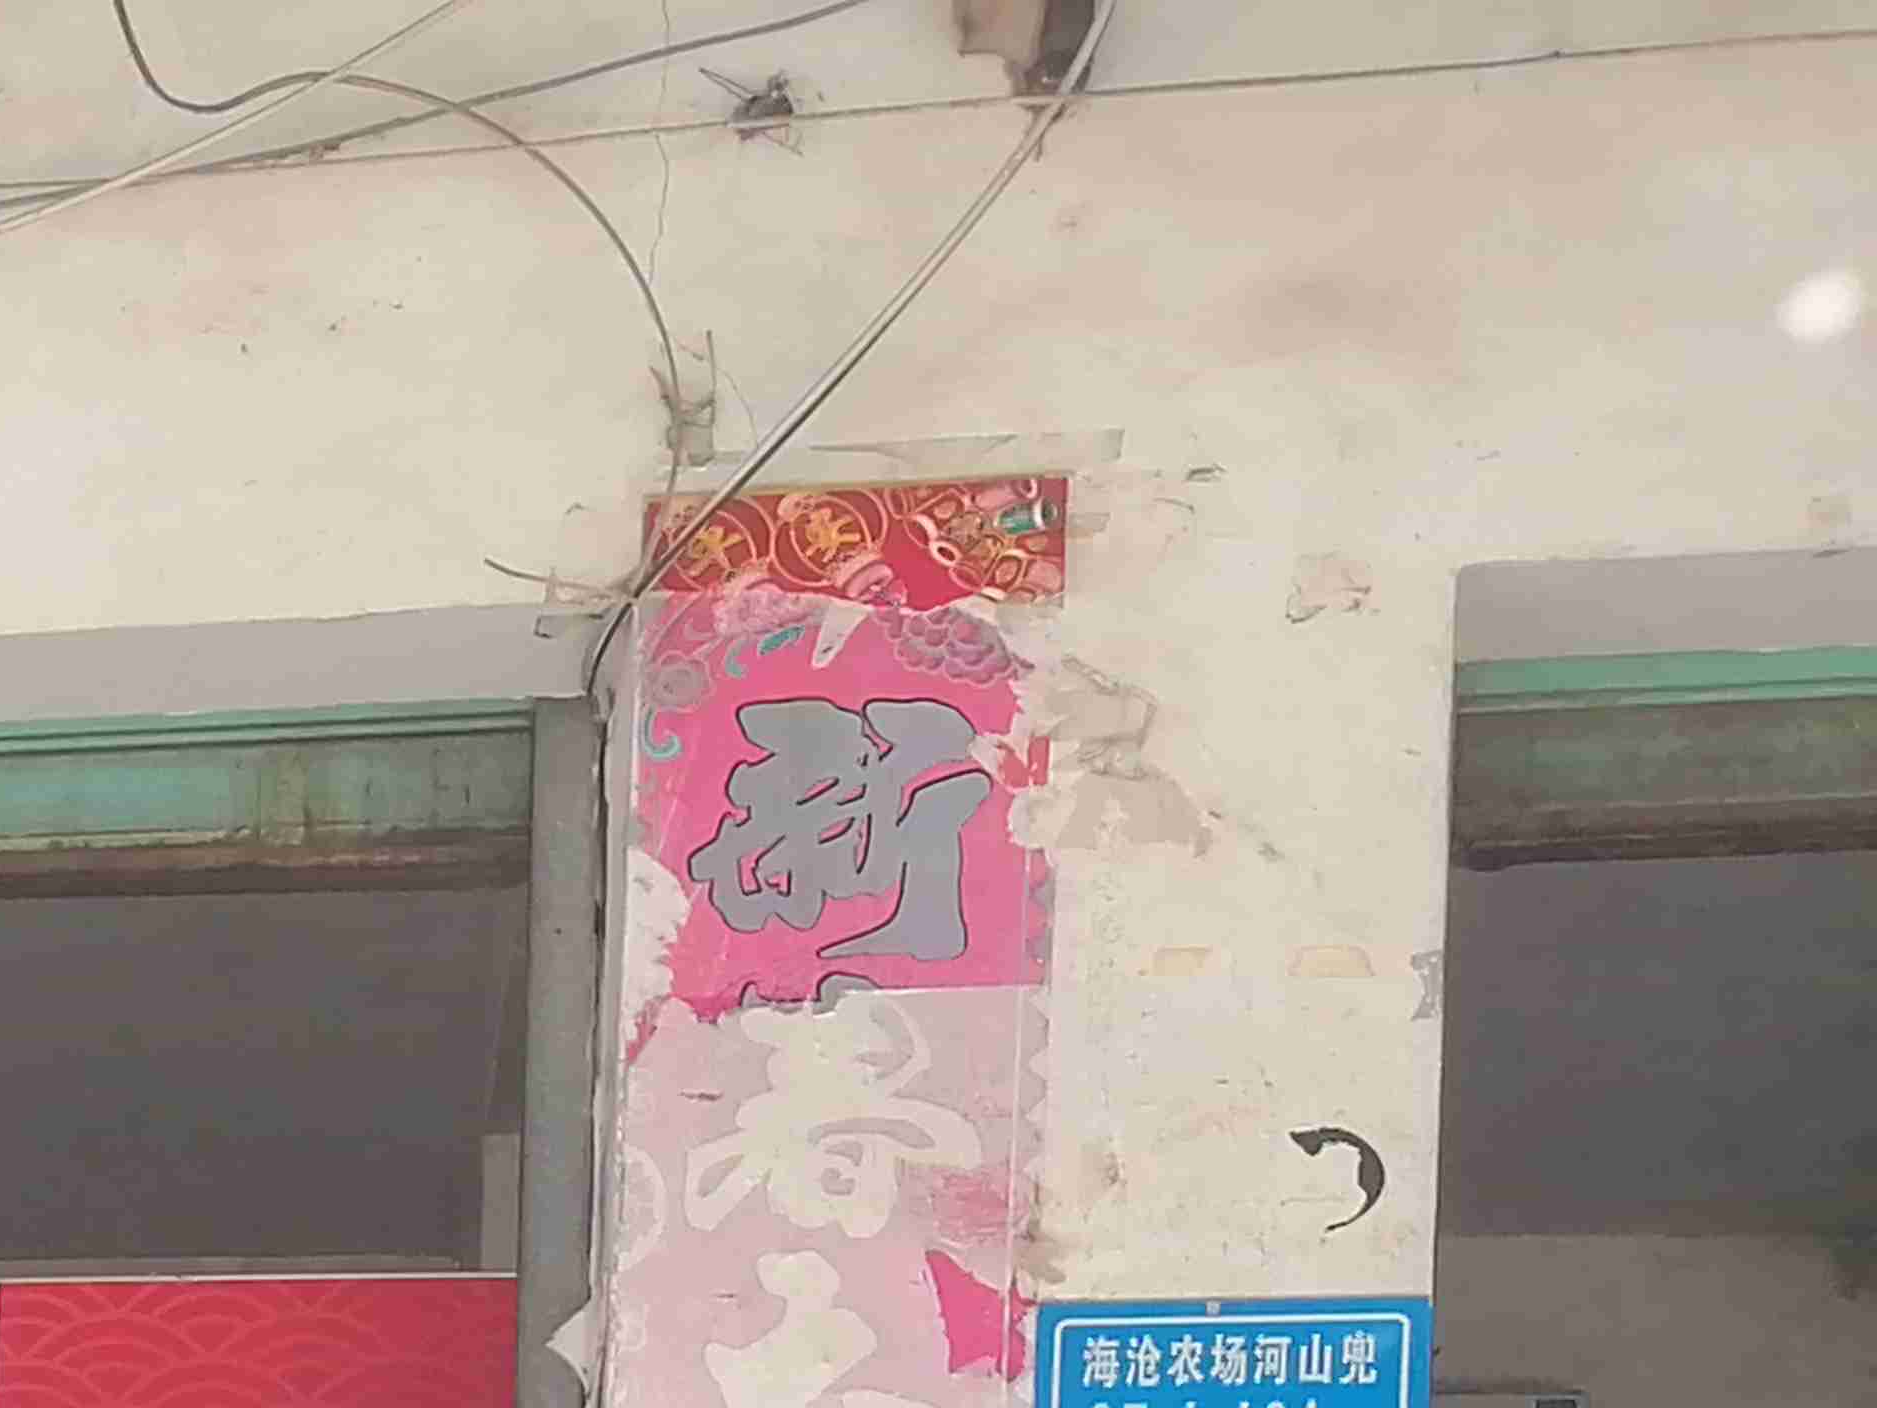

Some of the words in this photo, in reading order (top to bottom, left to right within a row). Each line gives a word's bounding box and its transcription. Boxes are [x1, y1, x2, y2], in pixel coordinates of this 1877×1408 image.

[1081, 1330, 1380, 1389] 海沧农场河山兜
